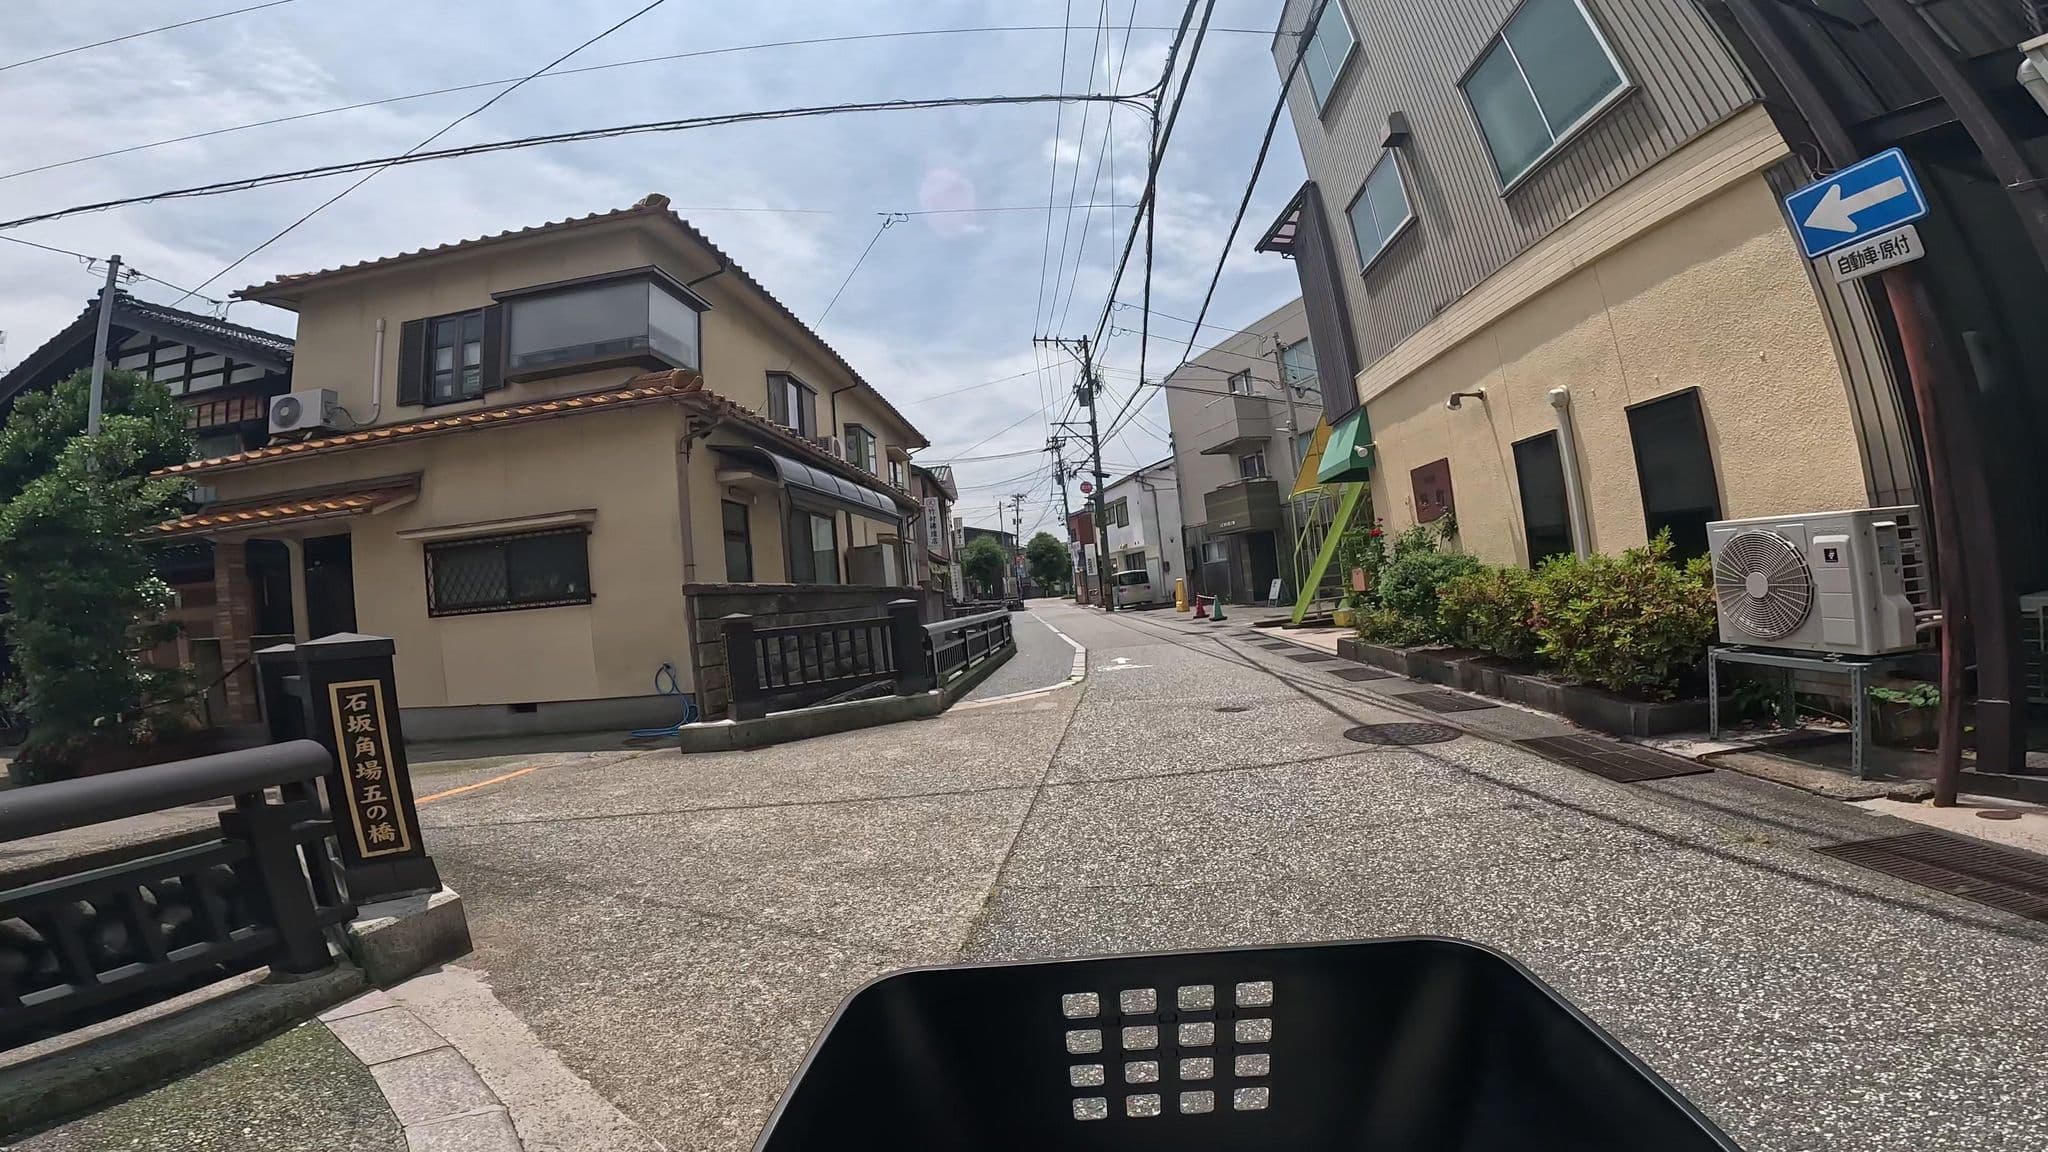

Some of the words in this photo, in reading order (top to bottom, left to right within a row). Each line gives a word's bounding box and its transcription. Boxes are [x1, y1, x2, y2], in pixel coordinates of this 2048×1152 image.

[344, 693, 396, 845] 石坂角場五の橋
